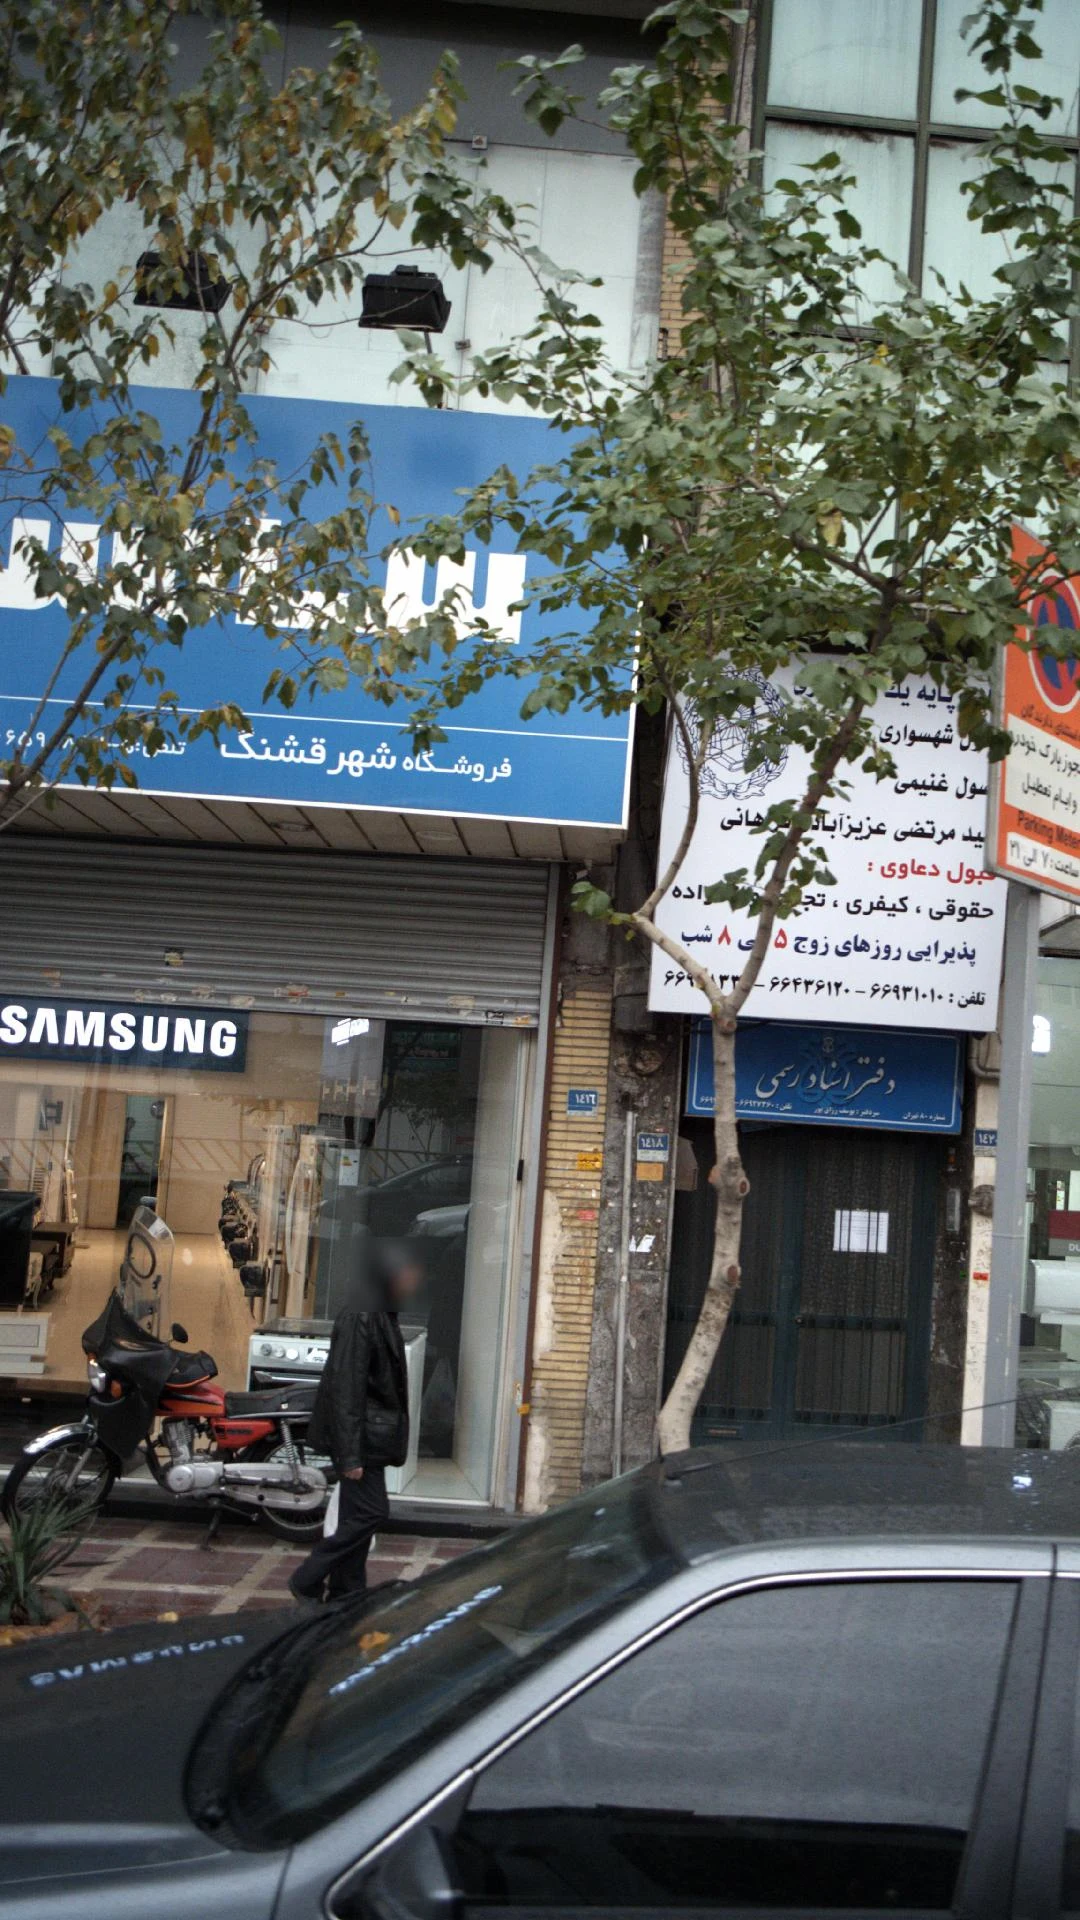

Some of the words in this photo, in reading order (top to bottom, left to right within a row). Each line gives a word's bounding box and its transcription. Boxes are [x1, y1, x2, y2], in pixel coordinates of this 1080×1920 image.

[220, 729, 326, 764] قشنگ
[880, 724, 954, 749] شهسواری
[1009, 730, 1036, 756] خودر
[327, 742, 396, 777] شهر
[402, 751, 512, 783] فروشگاه
[894, 773, 949, 797] غنیمی
[955, 776, 989, 799] سول
[893, 819, 955, 845] مرتضی
[962, 826, 985, 848] ید
[681, 925, 713, 947] شب
[717, 925, 731, 945] ۸
[774, 928, 788, 949] ۵
[793, 936, 829, 956] زوج
[834, 934, 902, 961] روزهای
[907, 940, 976, 967] پذیرایی
[769, 976, 850, 996] ۶۶۴۳۶۱۲۰
[870, 983, 943, 1003] ۶۶۹۳۱۰۱۰
[0, 1005, 238, 1057] SAMSUNG
[755, 1063, 800, 1099] رسمی
[807, 1061, 850, 1090] اسناد
[846, 1056, 896, 1100] دفتر
